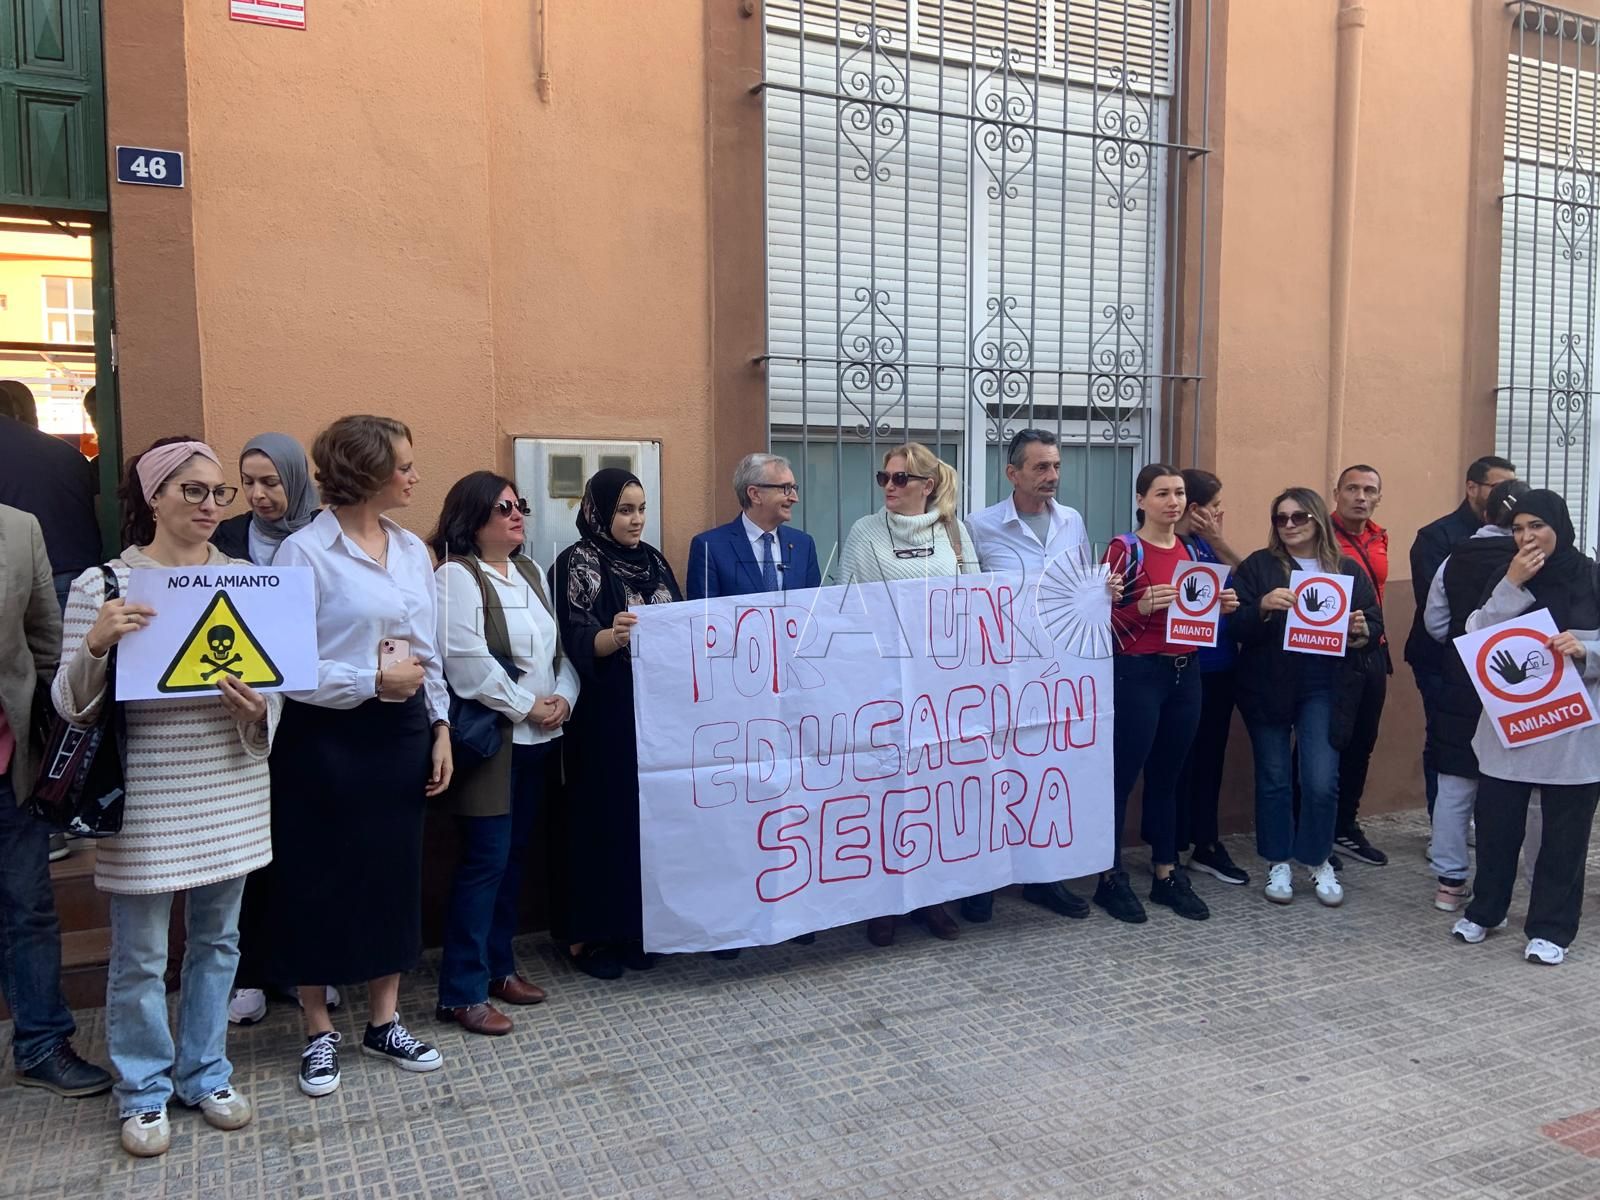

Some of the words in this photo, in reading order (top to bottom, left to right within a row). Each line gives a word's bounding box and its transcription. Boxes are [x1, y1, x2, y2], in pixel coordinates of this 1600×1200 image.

[130, 155, 167, 179] 46
[167, 576, 190, 589] NO
[192, 575, 212, 588] AL
[215, 575, 280, 588] AMIANTO
[690, 608, 825, 702] POR
[929, 584, 1055, 671] UNA
[1172, 624, 1213, 637] AMIANTO
[1290, 633, 1340, 647] AMIANTO
[1509, 703, 1583, 736] AMIANTO
[692, 662, 1097, 808] EDUCACIÓN
[756, 767, 1073, 902] SEGURA
